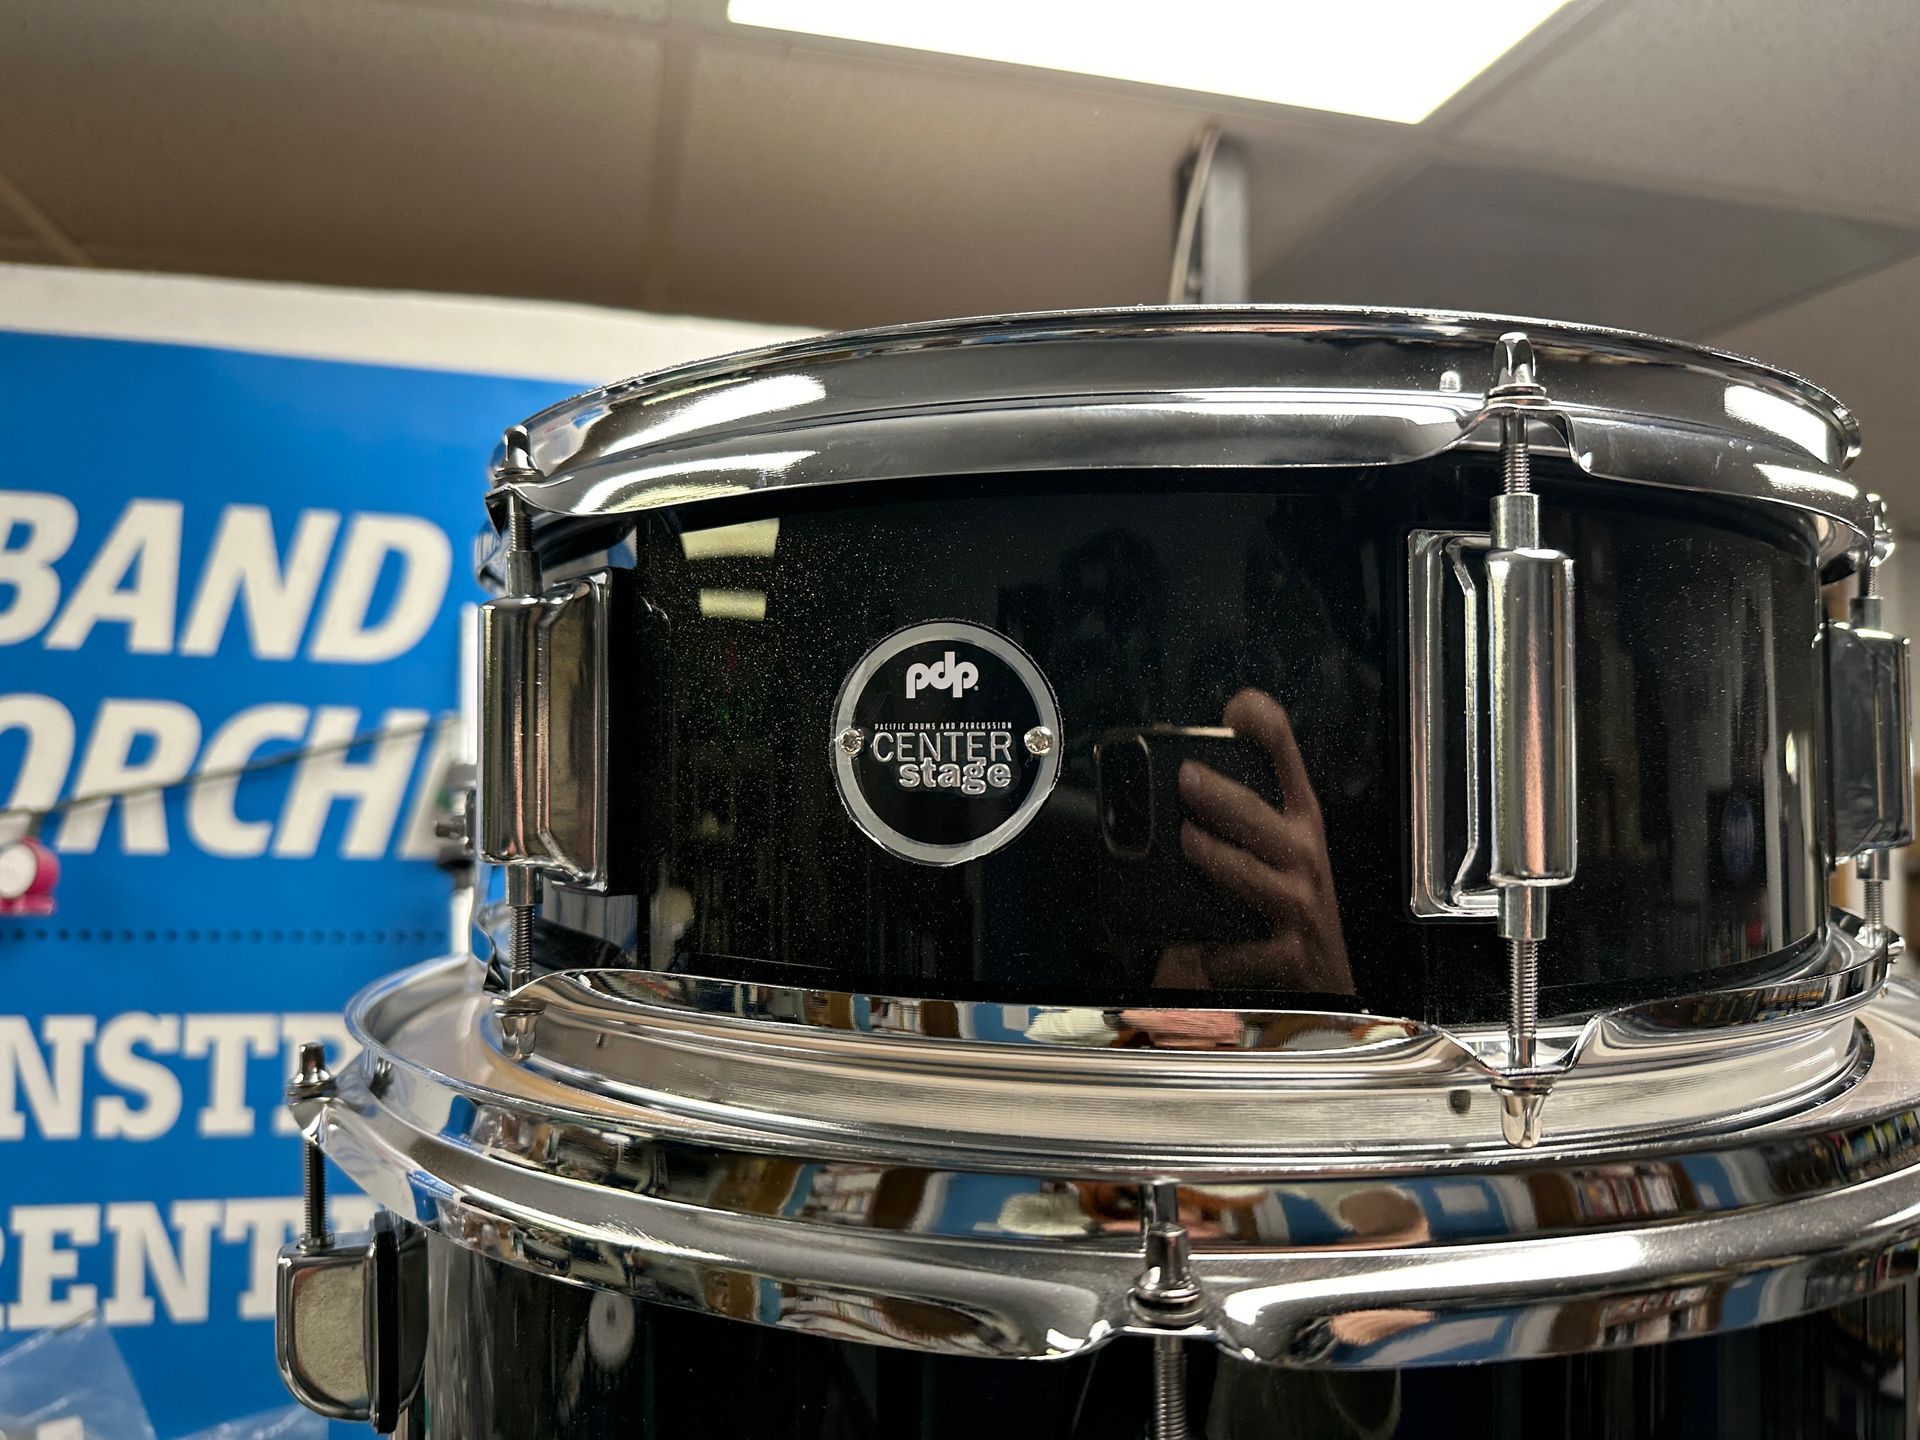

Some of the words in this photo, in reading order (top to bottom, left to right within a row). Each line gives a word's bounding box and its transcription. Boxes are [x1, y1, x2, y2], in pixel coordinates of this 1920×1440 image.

[0, 489, 454, 664] BAND
[872, 731, 1013, 763] CENTER
[874, 722, 906, 731] PACIFIC
[909, 722, 937, 731] DRUMS
[940, 722, 957, 731] AND
[960, 721, 1013, 731] PERCUSSION
[0, 692, 462, 861] ORCH
[898, 757, 1013, 796] stage
[0, 1194, 384, 1332] ENT
